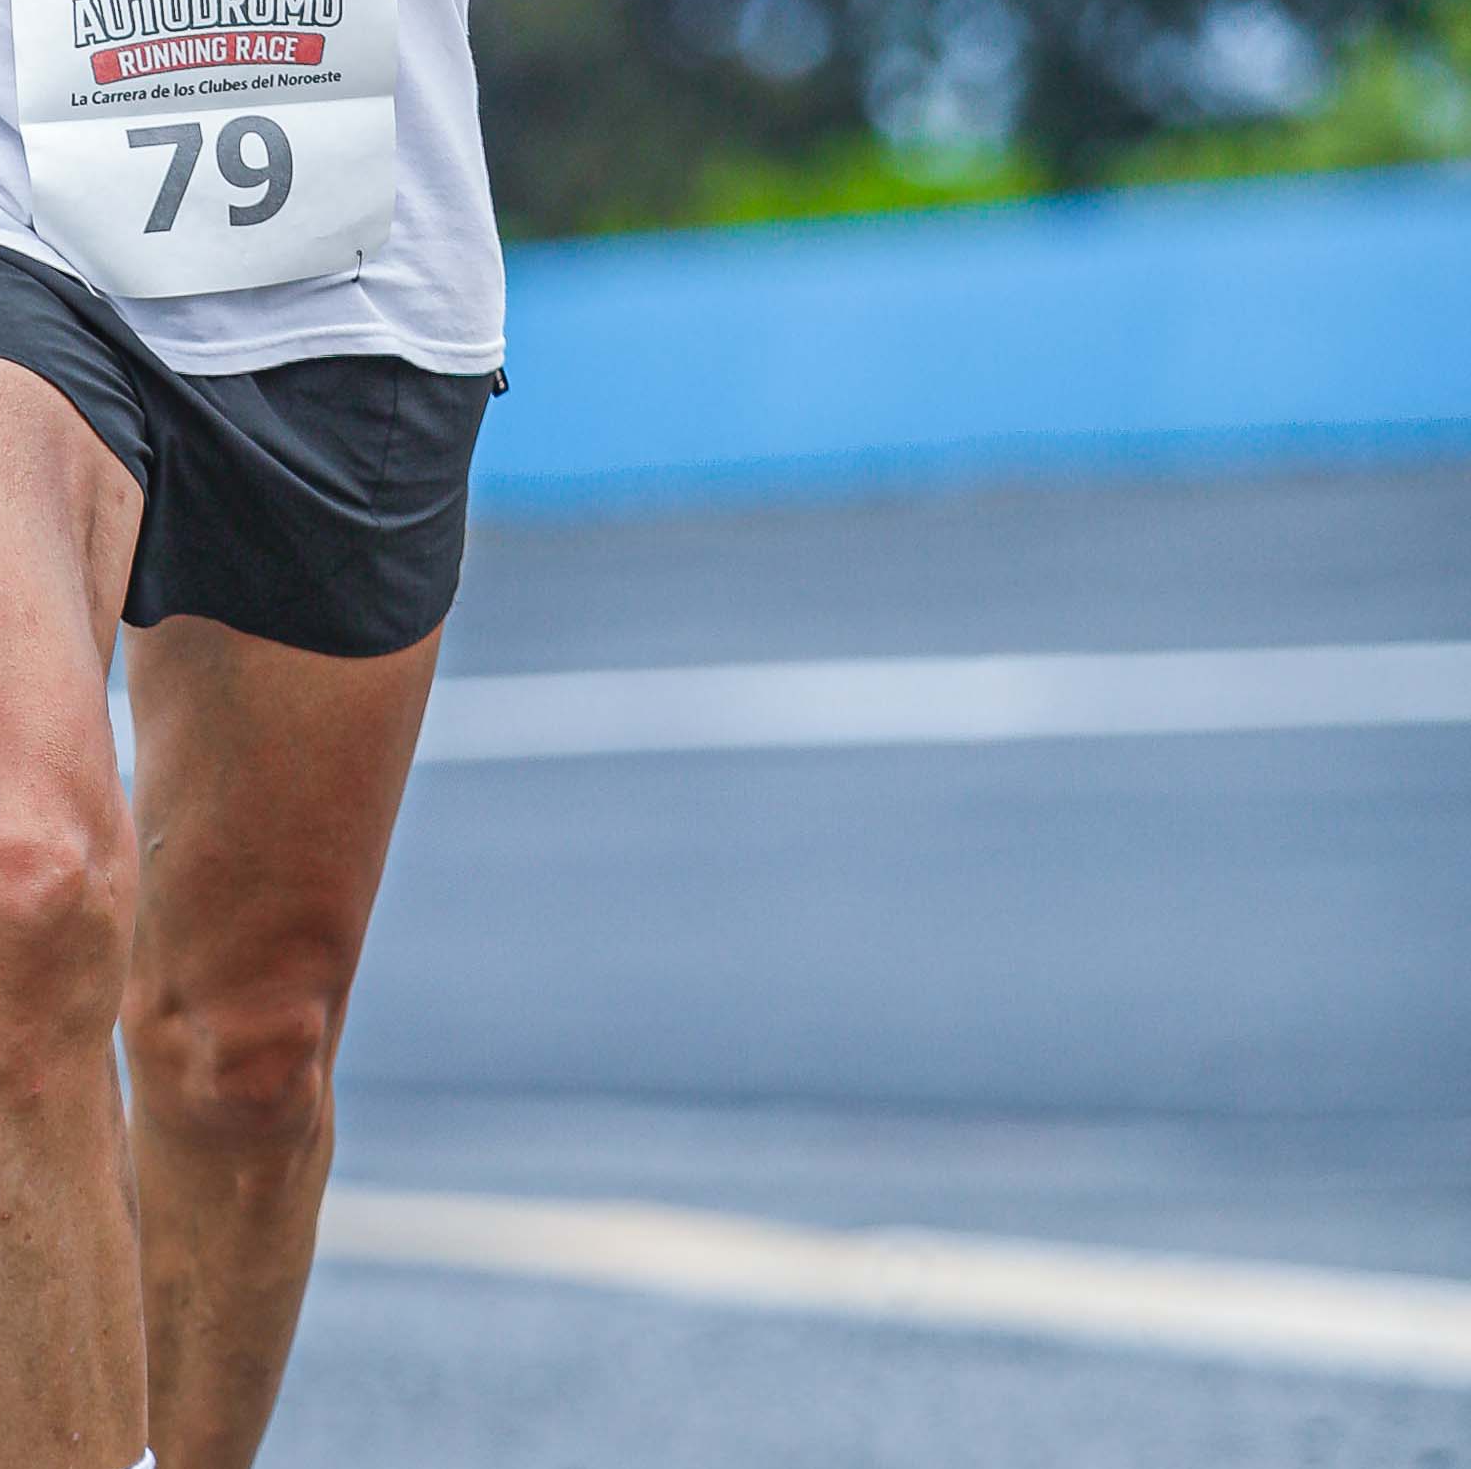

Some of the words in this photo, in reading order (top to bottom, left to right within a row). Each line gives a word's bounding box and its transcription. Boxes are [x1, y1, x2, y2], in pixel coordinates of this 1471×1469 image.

[118, 36, 227, 78] RUNNING
[235, 34, 299, 64] RACE
[71, 93, 89, 107] La
[92, 85, 147, 106] Carrera
[151, 82, 170, 99] de
[174, 82, 195, 98] los
[198, 78, 248, 96] Clubes
[252, 74, 274, 90] del
[278, 70, 342, 88] Noroeste
[126, 115, 294, 234] 79
